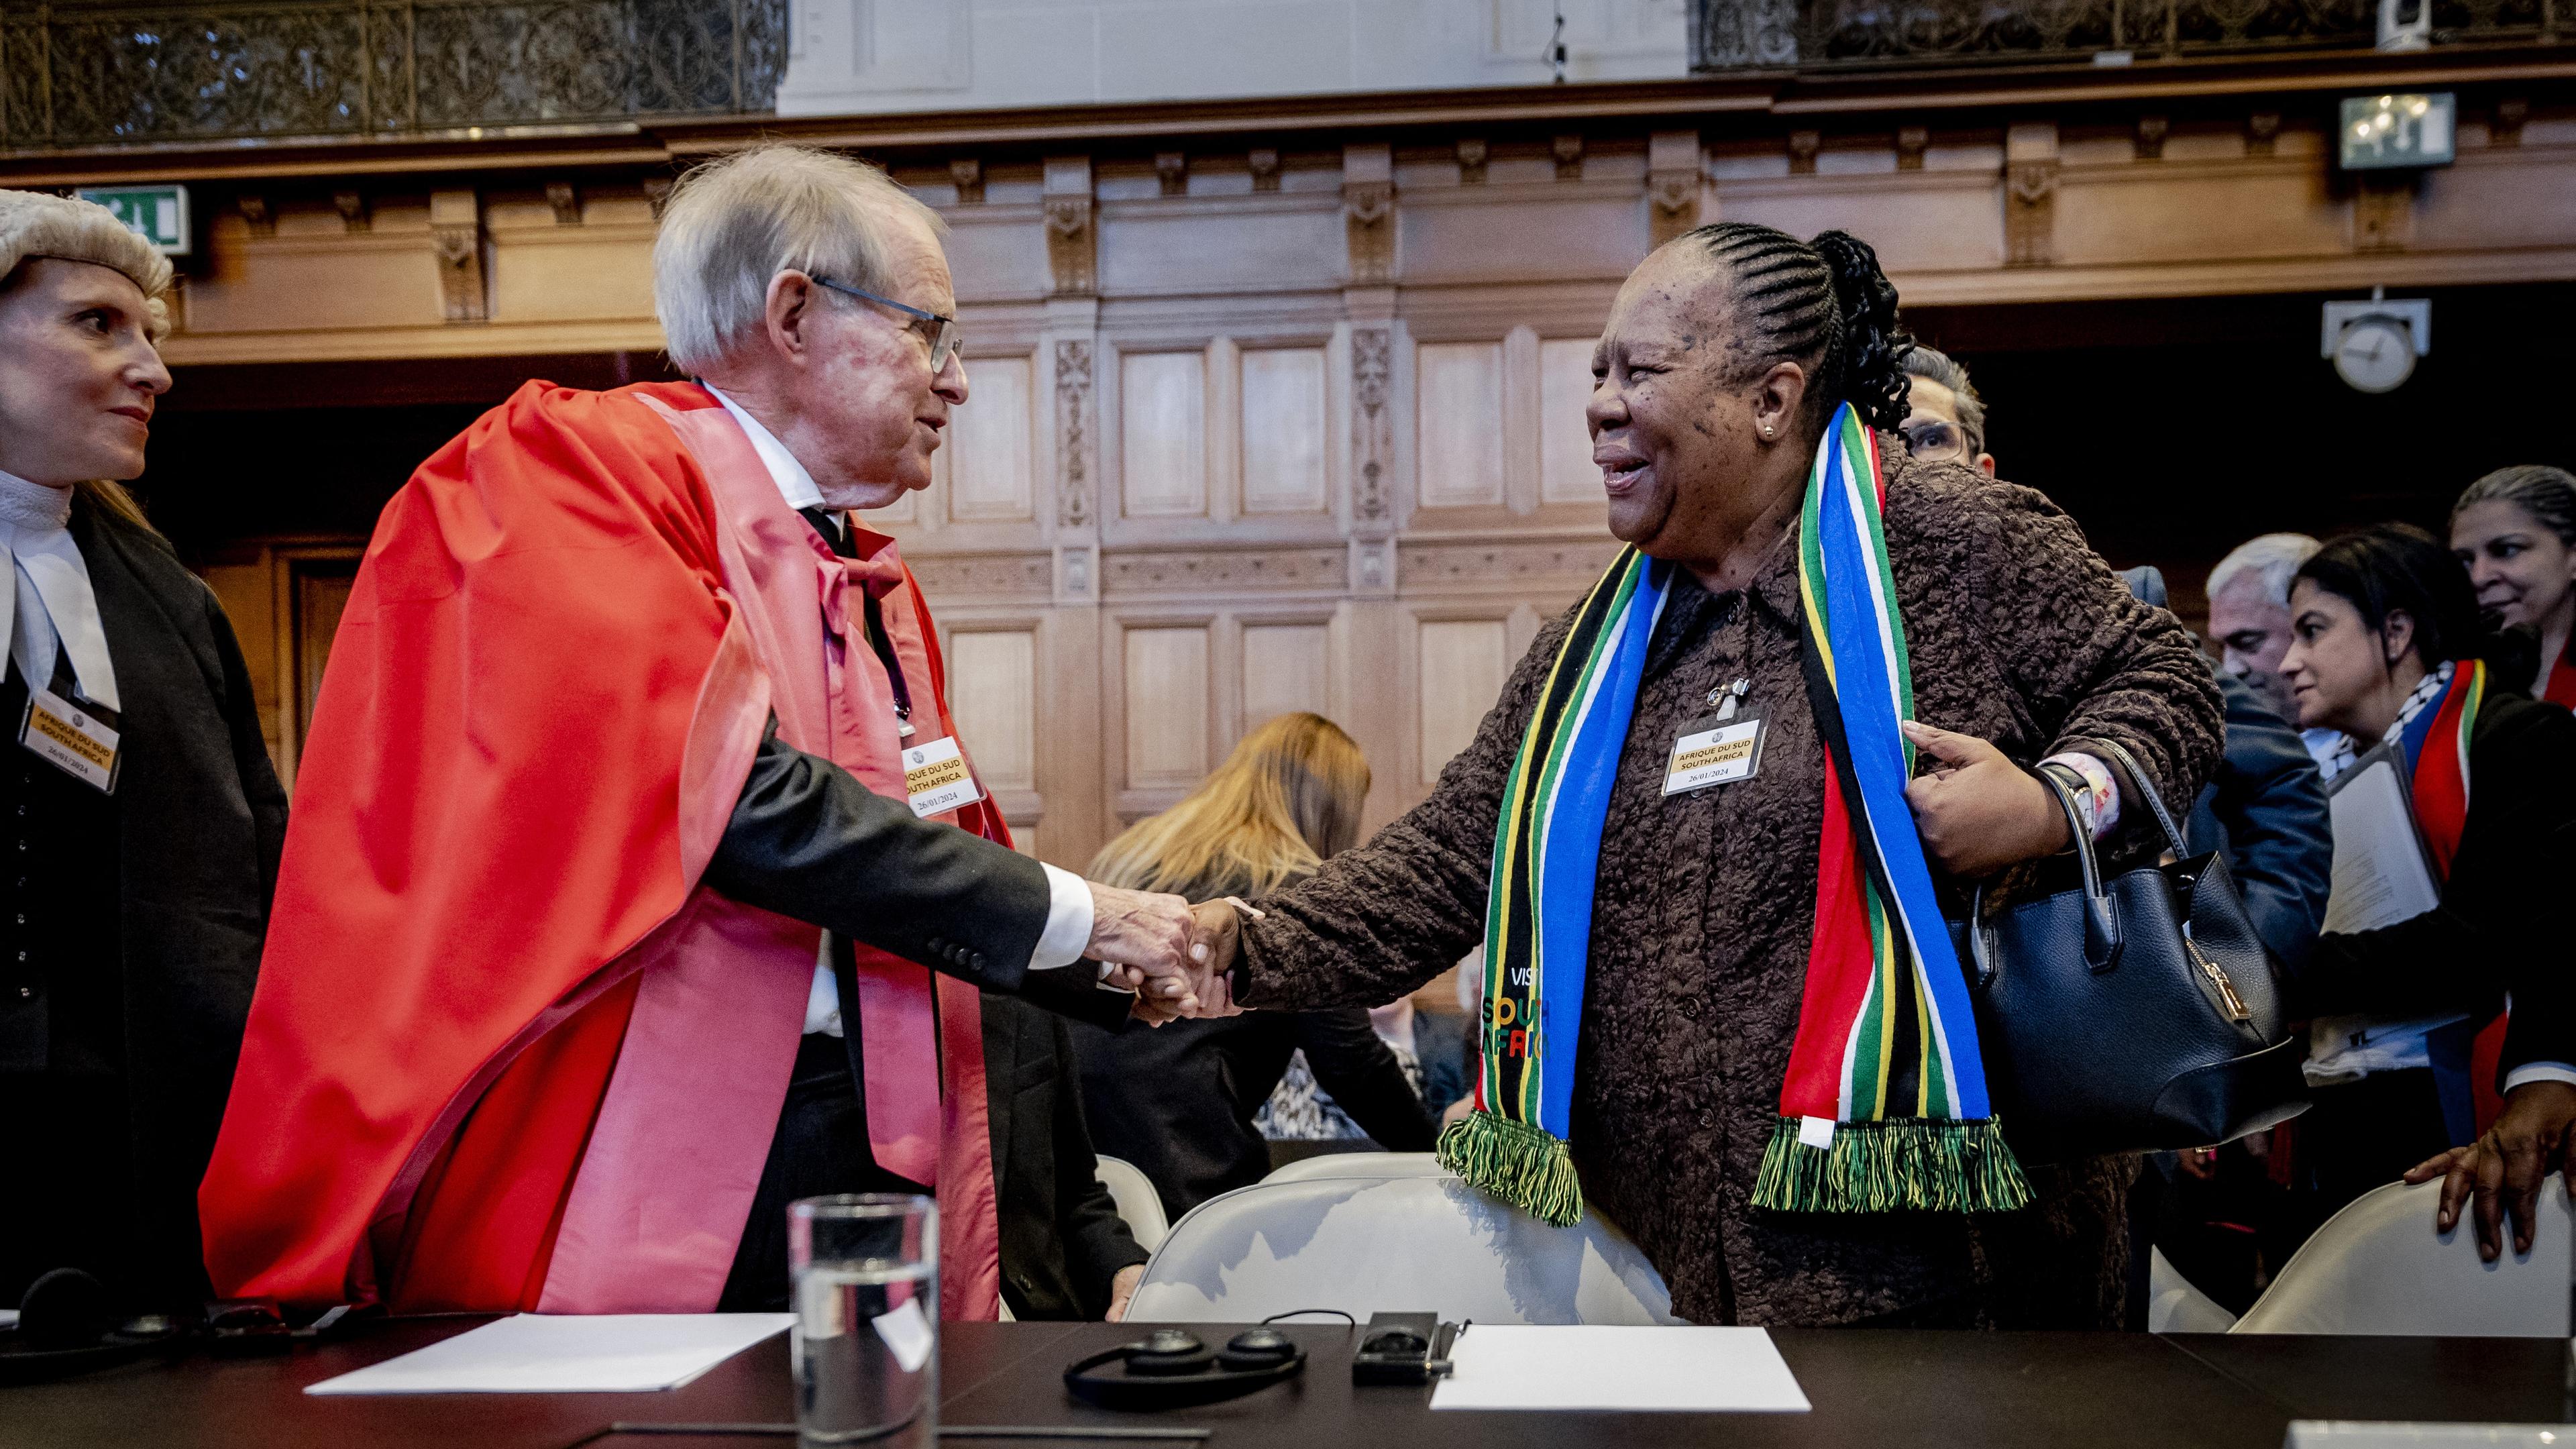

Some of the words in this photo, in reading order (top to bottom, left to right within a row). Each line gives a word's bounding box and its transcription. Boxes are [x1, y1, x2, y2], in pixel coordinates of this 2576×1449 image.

[39, 711, 76, 737] AFRIQUE
[78, 735, 91, 746] DU
[93, 743, 111, 757] SUD
[41, 724, 72, 747] SOUTH
[72, 743, 103, 765] AFRICA
[1678, 747, 1716, 761] AFRIQUE
[1717, 744, 1731, 753] DU
[1732, 740, 1751, 749] SUD
[1681, 757, 1711, 770] SOUTH
[1712, 751, 1743, 763] AFRICA
[904, 769, 927, 782] IQUE
[928, 765, 941, 774] DU
[943, 759, 961, 770] SUD
[1688, 768, 1729, 782] 26/01/2024
[907, 781, 930, 794] OUTH
[931, 772, 961, 787] AFRICA
[918, 792, 958, 810] 26/01/2024
